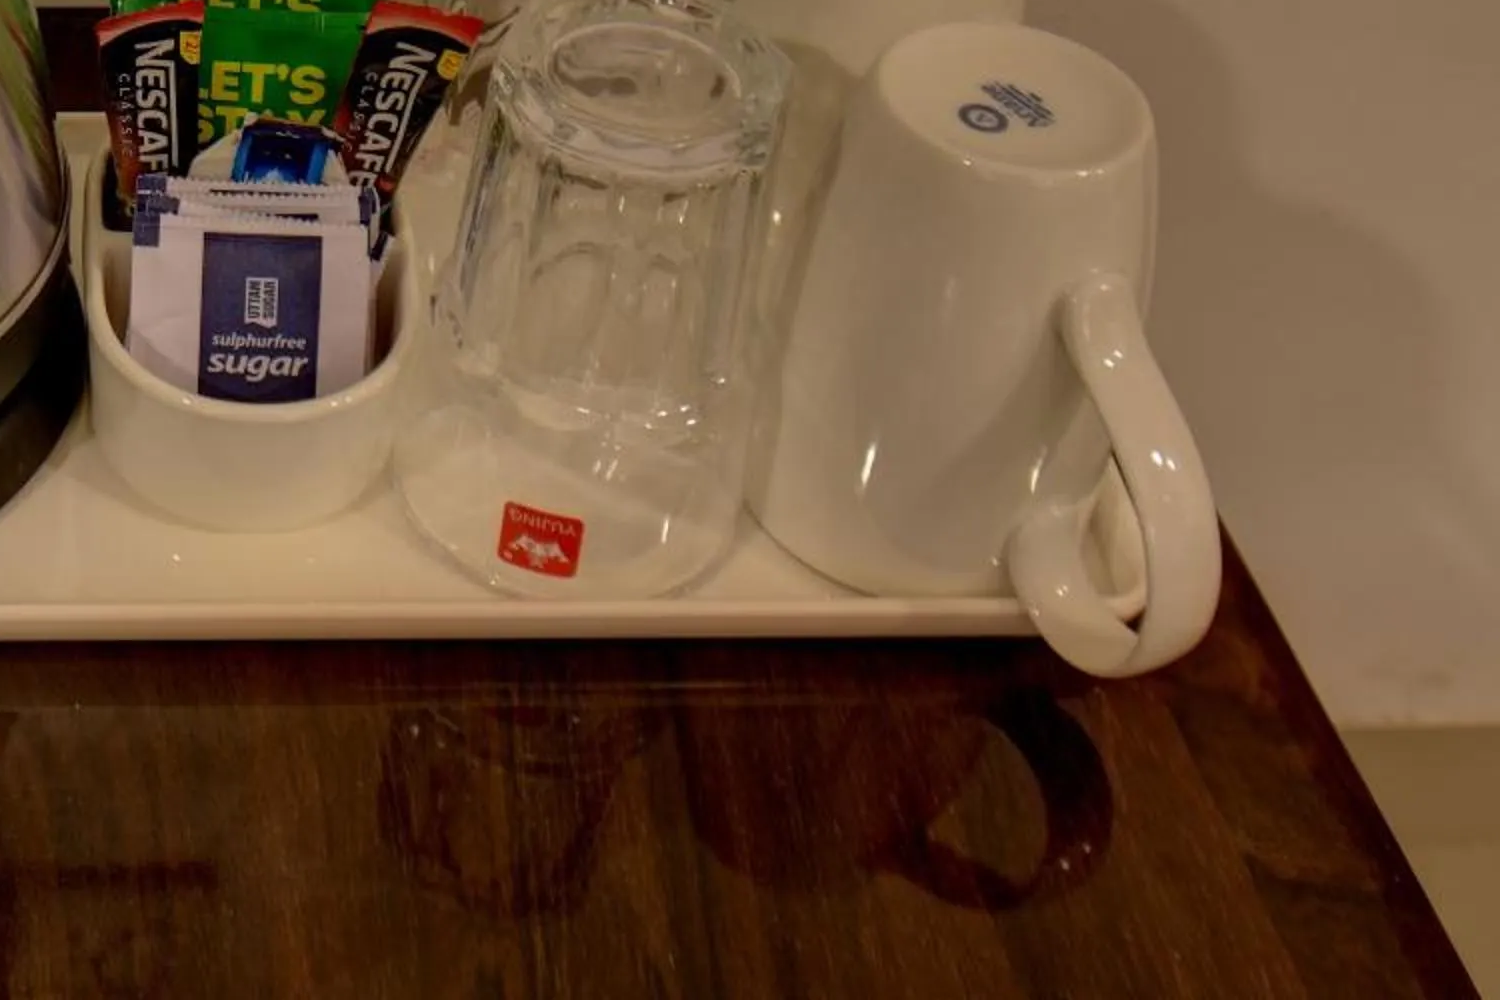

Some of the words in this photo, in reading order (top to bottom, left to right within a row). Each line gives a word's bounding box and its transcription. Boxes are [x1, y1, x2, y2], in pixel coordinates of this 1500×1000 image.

[197, 60, 326, 105] ET'S
[134, 38, 179, 174] NESCAF
[211, 331, 307, 351] sulphurfree
[206, 353, 309, 383] sugar
